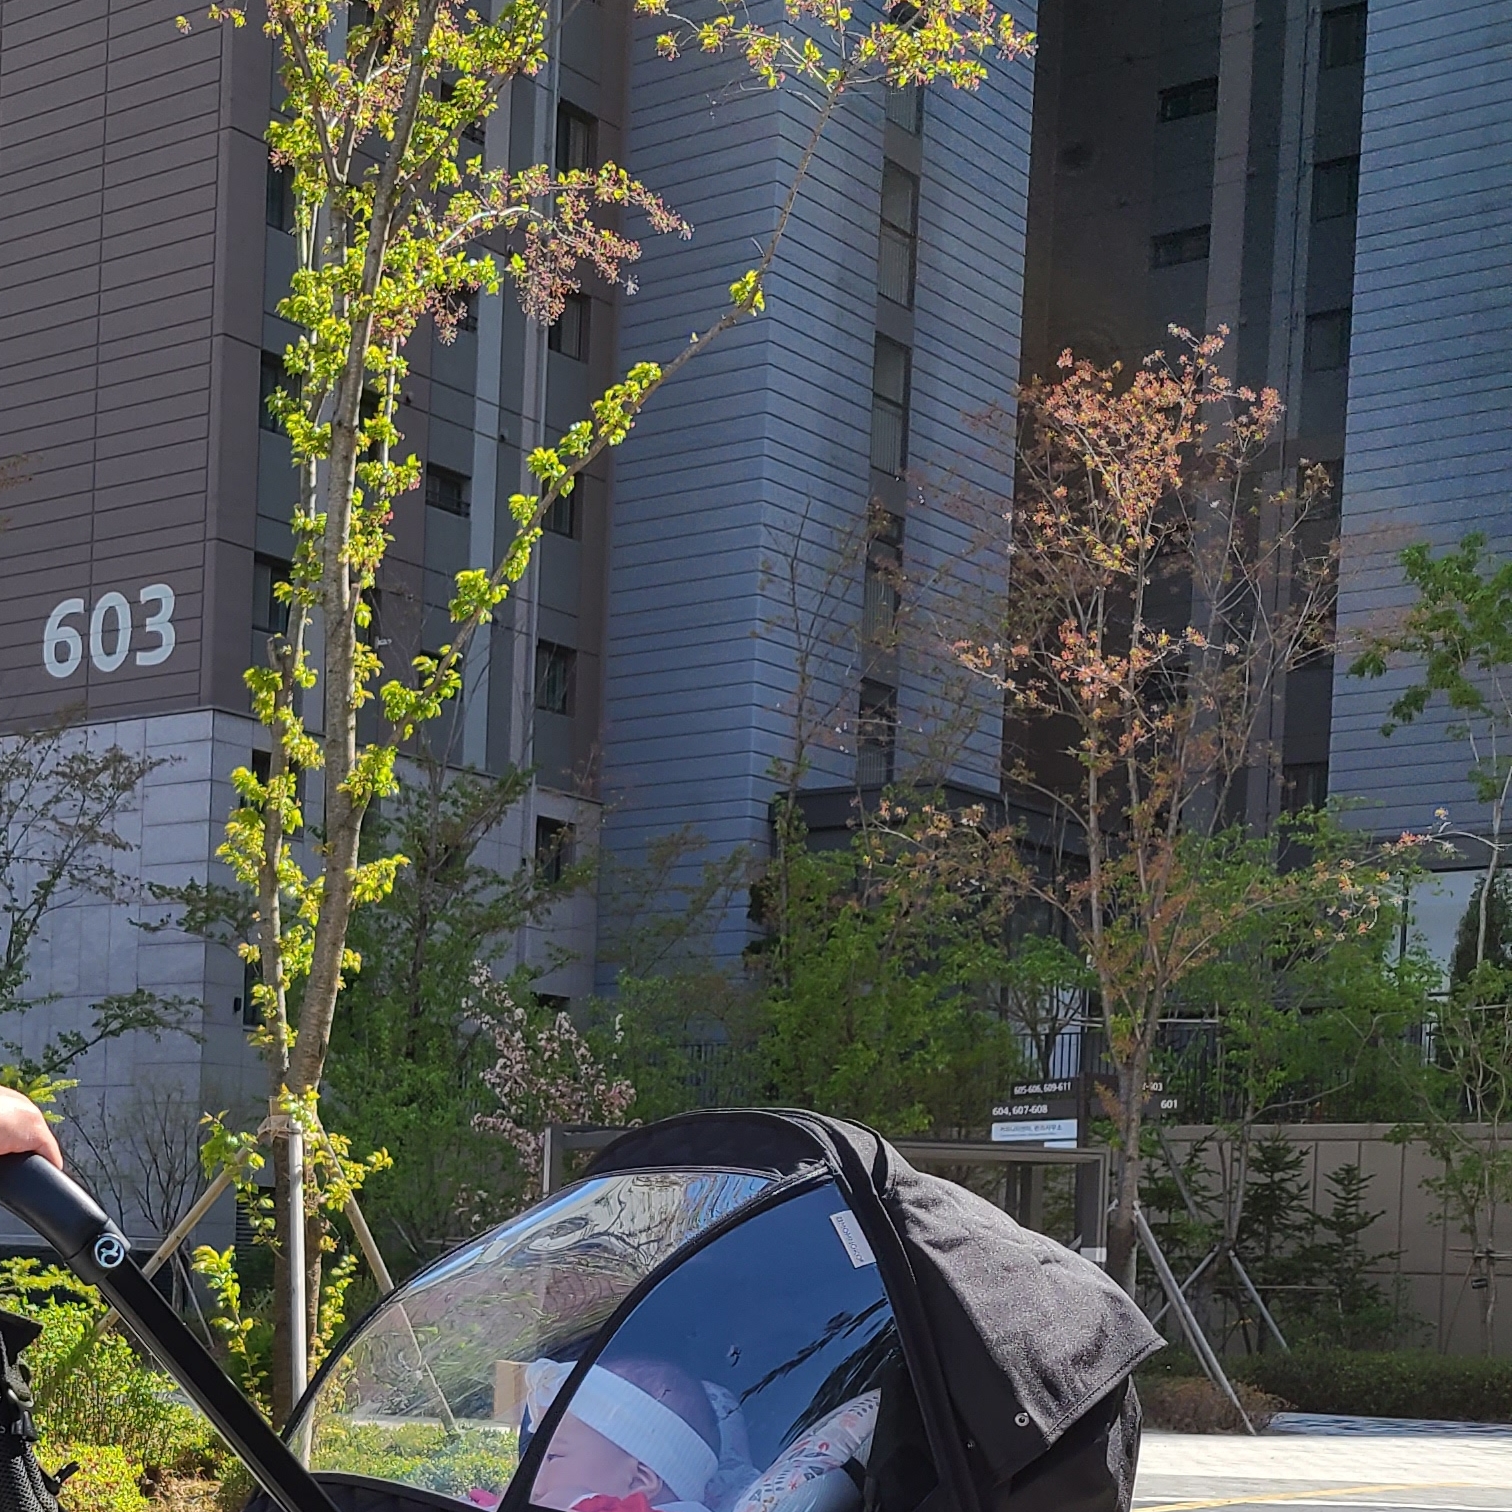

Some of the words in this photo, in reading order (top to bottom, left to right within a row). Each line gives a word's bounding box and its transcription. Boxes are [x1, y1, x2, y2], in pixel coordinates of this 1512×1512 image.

[43, 583, 176, 678] 603
[1160, 1098, 1178, 1109] 601
[1012, 1104, 1048, 1115] 607-608
